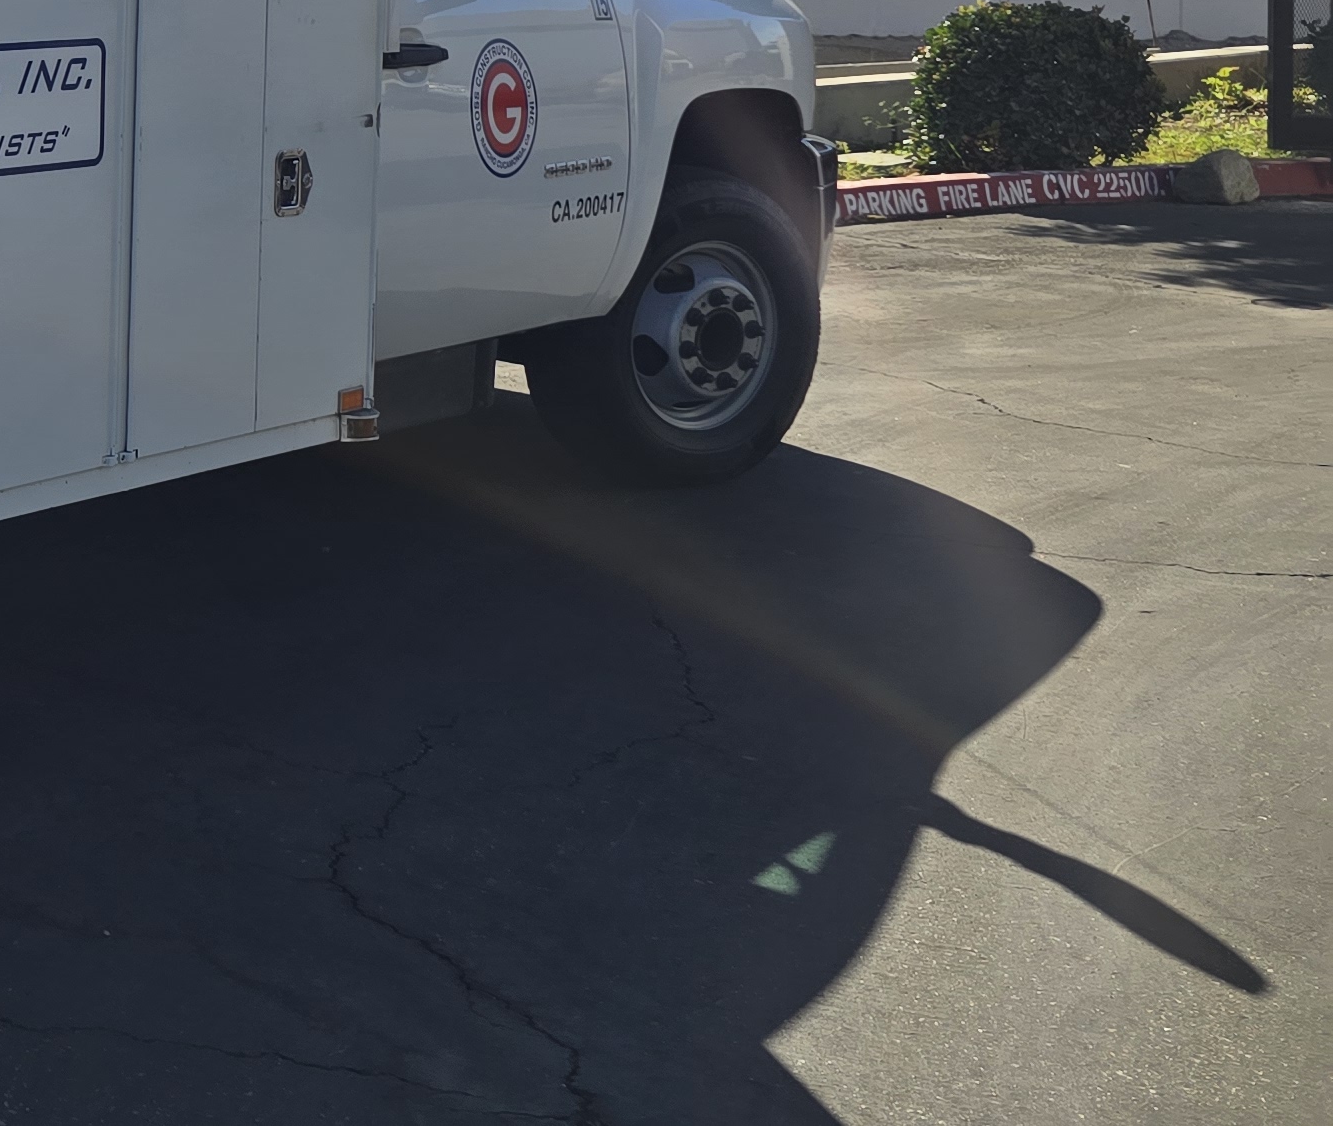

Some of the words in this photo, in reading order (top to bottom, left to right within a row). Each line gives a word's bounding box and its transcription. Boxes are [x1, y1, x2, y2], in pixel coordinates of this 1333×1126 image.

[17, 57, 93, 95] INC.
[475, 45, 523, 87] CONSTRUCTION
[488, 73, 522, 144] G
[551, 192, 625, 223] CA.200417
[843, 188, 928, 217] PARKING
[937, 183, 982, 211] FIRE
[985, 179, 1036, 207] LANE
[1042, 173, 1090, 200] CVC
